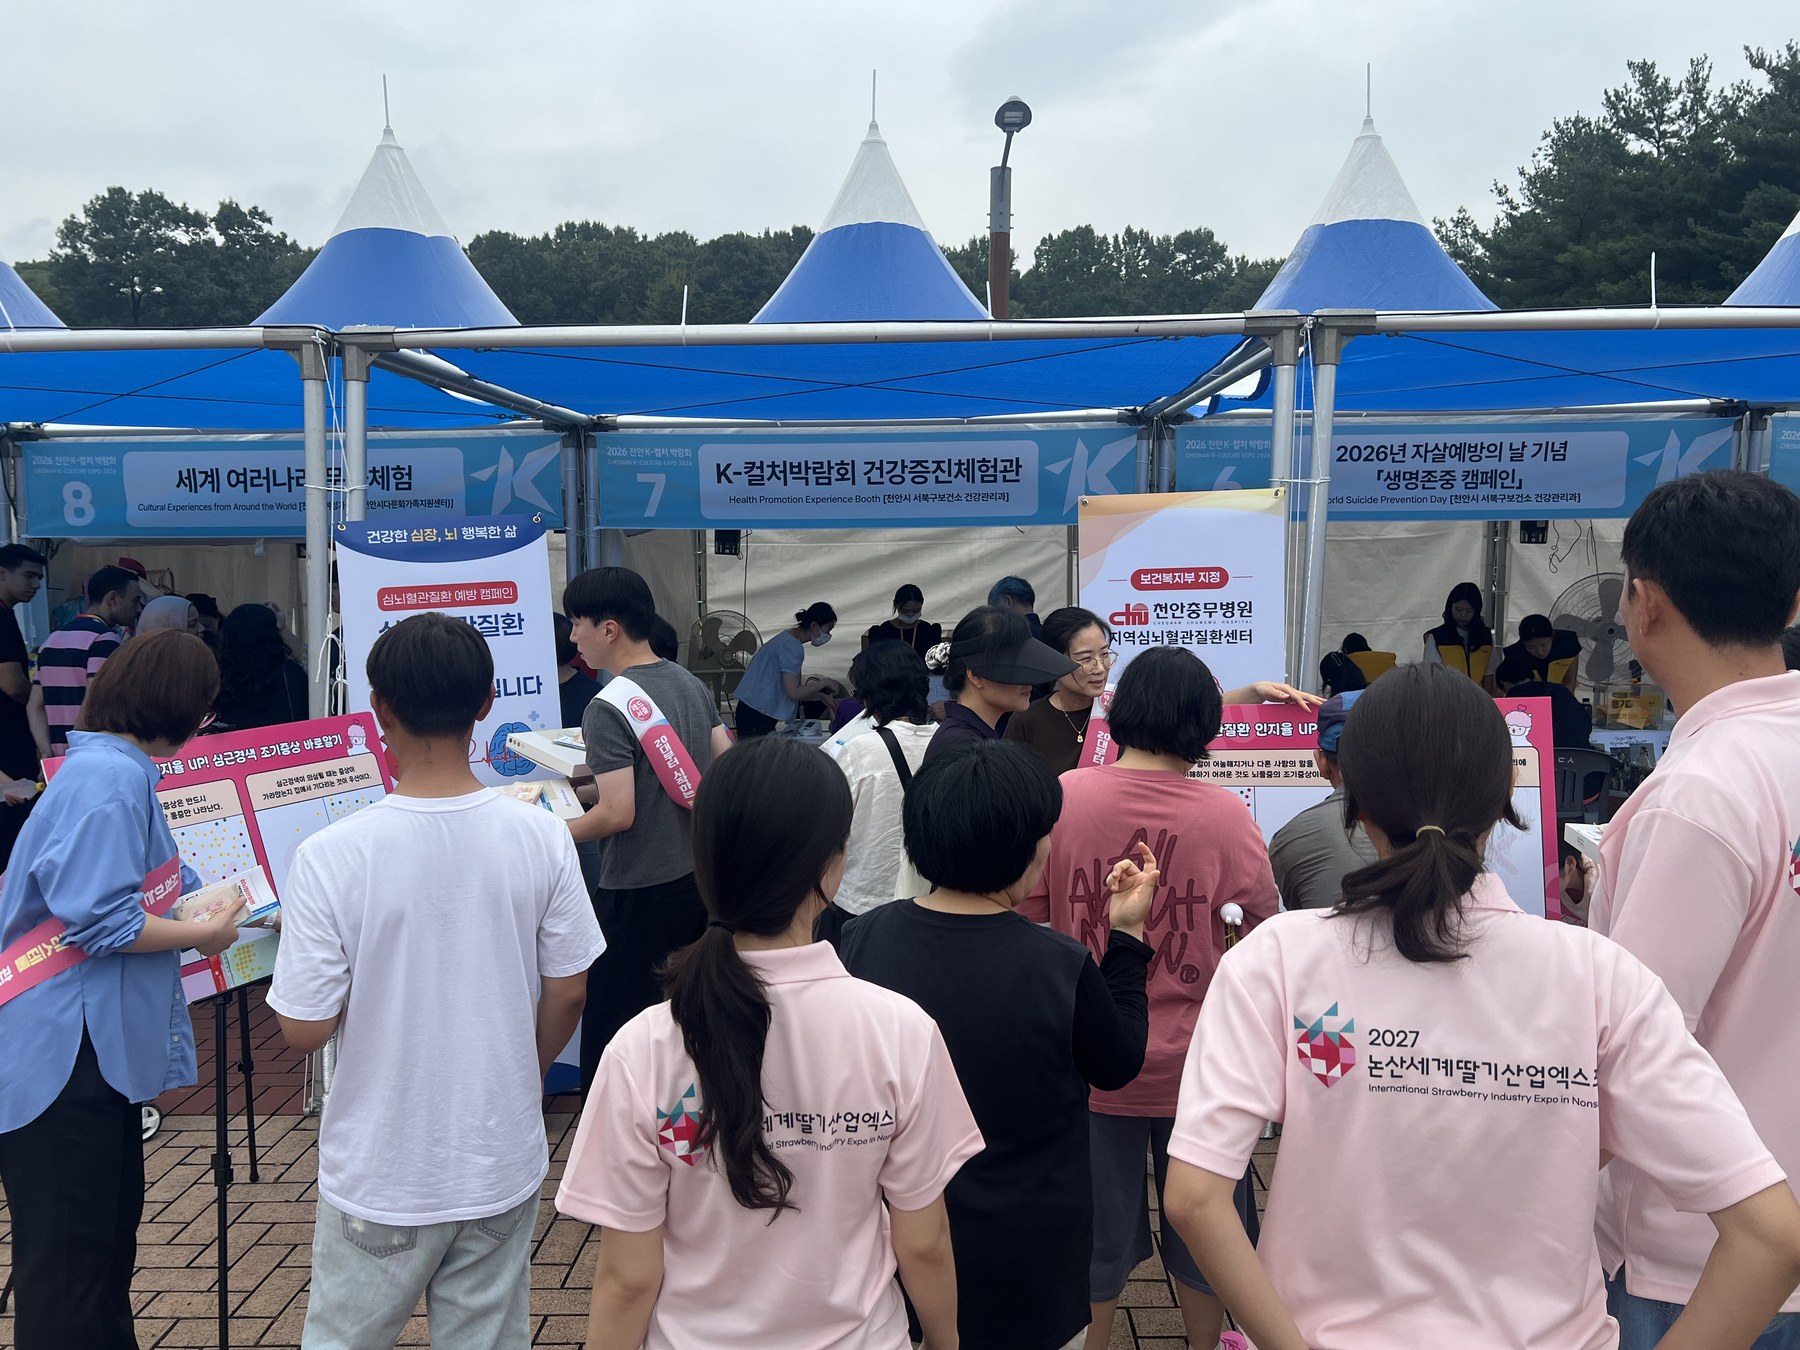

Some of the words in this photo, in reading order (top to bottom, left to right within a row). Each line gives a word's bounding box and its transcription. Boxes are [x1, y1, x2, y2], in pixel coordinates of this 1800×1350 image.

[607, 447, 627, 456] 2026
[670, 448, 692, 457] 박람회
[1186, 440, 1206, 449] 2026
[1249, 440, 1271, 450] 박람회
[1336, 443, 1407, 463] 2026년
[1411, 441, 1504, 463] 자살예방의
[1509, 441, 1528, 463] 날
[1531, 440, 1569, 462] 기념
[32, 456, 53, 465] 2026
[94, 456, 116, 466] 박람회
[176, 467, 220, 494] 세계
[325, 464, 413, 493] 문체험
[716, 460, 856, 486] K-컬처박람회
[863, 457, 1023, 486] 건강증진체험관
[62, 481, 95, 526] 8
[636, 473, 666, 517] 7
[729, 495, 757, 504] Health
[759, 495, 804, 504] Promotion
[805, 495, 853, 505] Experience
[855, 494, 881, 503] Booth
[883, 494, 911, 504] [천안시
[913, 493, 962, 503] 서북구보건소
[964, 491, 1009, 502] 건강관리과]
[1327, 496, 1344, 504] orld
[1345, 495, 1379, 504] Suicide
[1380, 495, 1428, 504] Prevention
[1430, 495, 1447, 505] Day
[1450, 494, 1479, 504] [천안시
[1481, 493, 1532, 503] 서북구보건소
[1534, 492, 1581, 503] 건강관리과]
[137, 503, 166, 512] Cultural
[167, 503, 212, 513] Experiences
[213, 503, 231, 511] from
[232, 503, 260, 511] Around
[261, 502, 274, 511] the
[275, 502, 298, 511] World
[367, 529, 408, 544] 건강한
[411, 529, 442, 543] 심장,
[445, 528, 458, 541] 뇌
[461, 526, 501, 540] 행복한
[504, 525, 517, 538] 삶
[1140, 573, 1195, 585] 보건복지부
[1198, 571, 1221, 583] 지정
[382, 591, 453, 606] 심뇌혈관질환
[455, 589, 478, 601] 예방
[479, 587, 514, 600] 캠페인
[1153, 601, 1253, 619] 천안충무병원
[1110, 629, 1253, 645] 지역심뇌혈관질환센터
[1255, 722, 1293, 737] 인지율
[1298, 722, 1320, 735] UP
[187, 757, 210, 772] UP!
[212, 746, 257, 768] 심근경색
[259, 741, 301, 758] 조기증상
[303, 733, 343, 751] 바로알기
[1257, 760, 1271, 768] 다른
[1274, 760, 1296, 768] 사람의
[1299, 760, 1313, 768] 말을
[1235, 770, 1249, 778] 것도
[1283, 770, 1322, 778] 조기증상이
[160, 798, 184, 811] 증상은
[185, 794, 207, 806] 반드시
[1368, 1028, 1420, 1048] 2027
[1367, 1054, 1598, 1091] 논산세계딸기산업엑스
[1368, 1084, 1429, 1095] International
[1431, 1087, 1489, 1102] Strawberry
[1491, 1092, 1531, 1104] Industry
[1533, 1094, 1559, 1105] Expo
[1560, 1095, 1570, 1104] in
[1571, 1096, 1599, 1109] Nons
[847, 1137, 868, 1147] Expo
